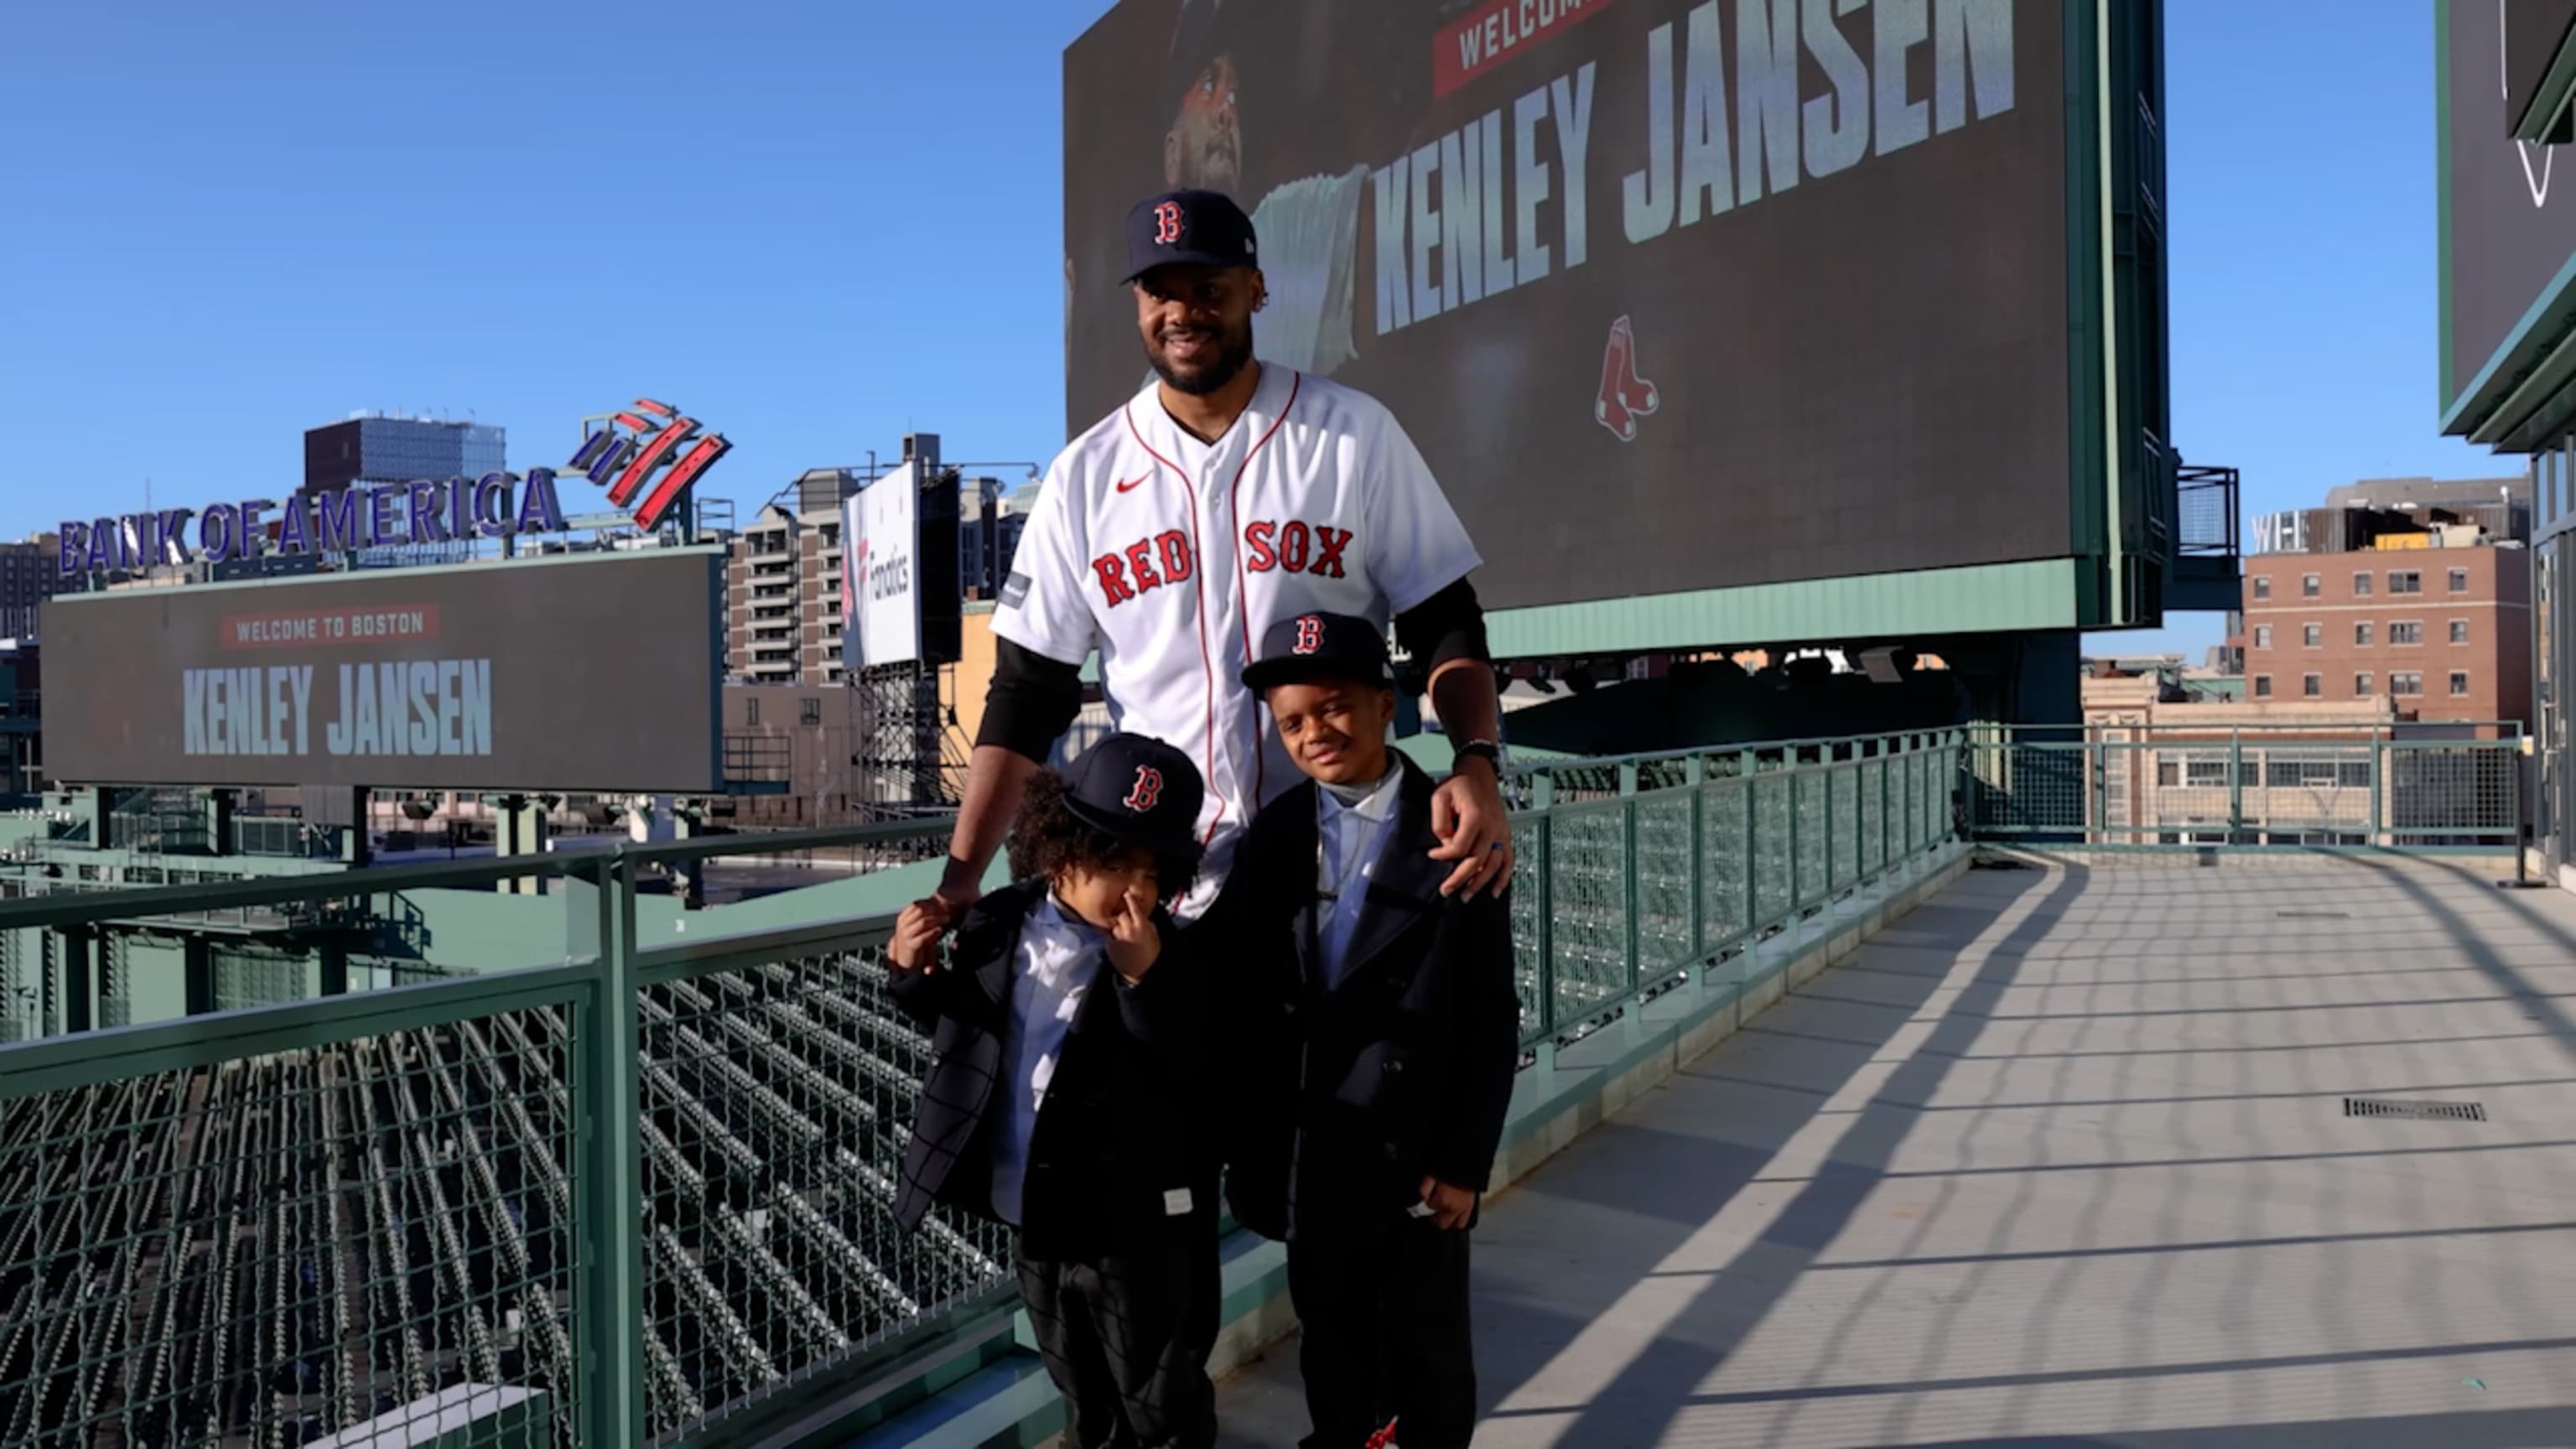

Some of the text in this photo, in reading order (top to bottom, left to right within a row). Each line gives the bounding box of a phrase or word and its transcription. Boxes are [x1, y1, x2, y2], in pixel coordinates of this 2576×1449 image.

[1154, 201, 1185, 244] B
[1374, 60, 1597, 335] KENLEY
[60, 467, 563, 576] BANK OF AMERICA
[1092, 520, 1353, 608] RED SOX
[236, 611, 423, 643] WELCOME TO BOSTON
[1292, 615, 1326, 655] B
[183, 658, 492, 756] KENLEY JANSEN
[1123, 765, 1164, 813] B
